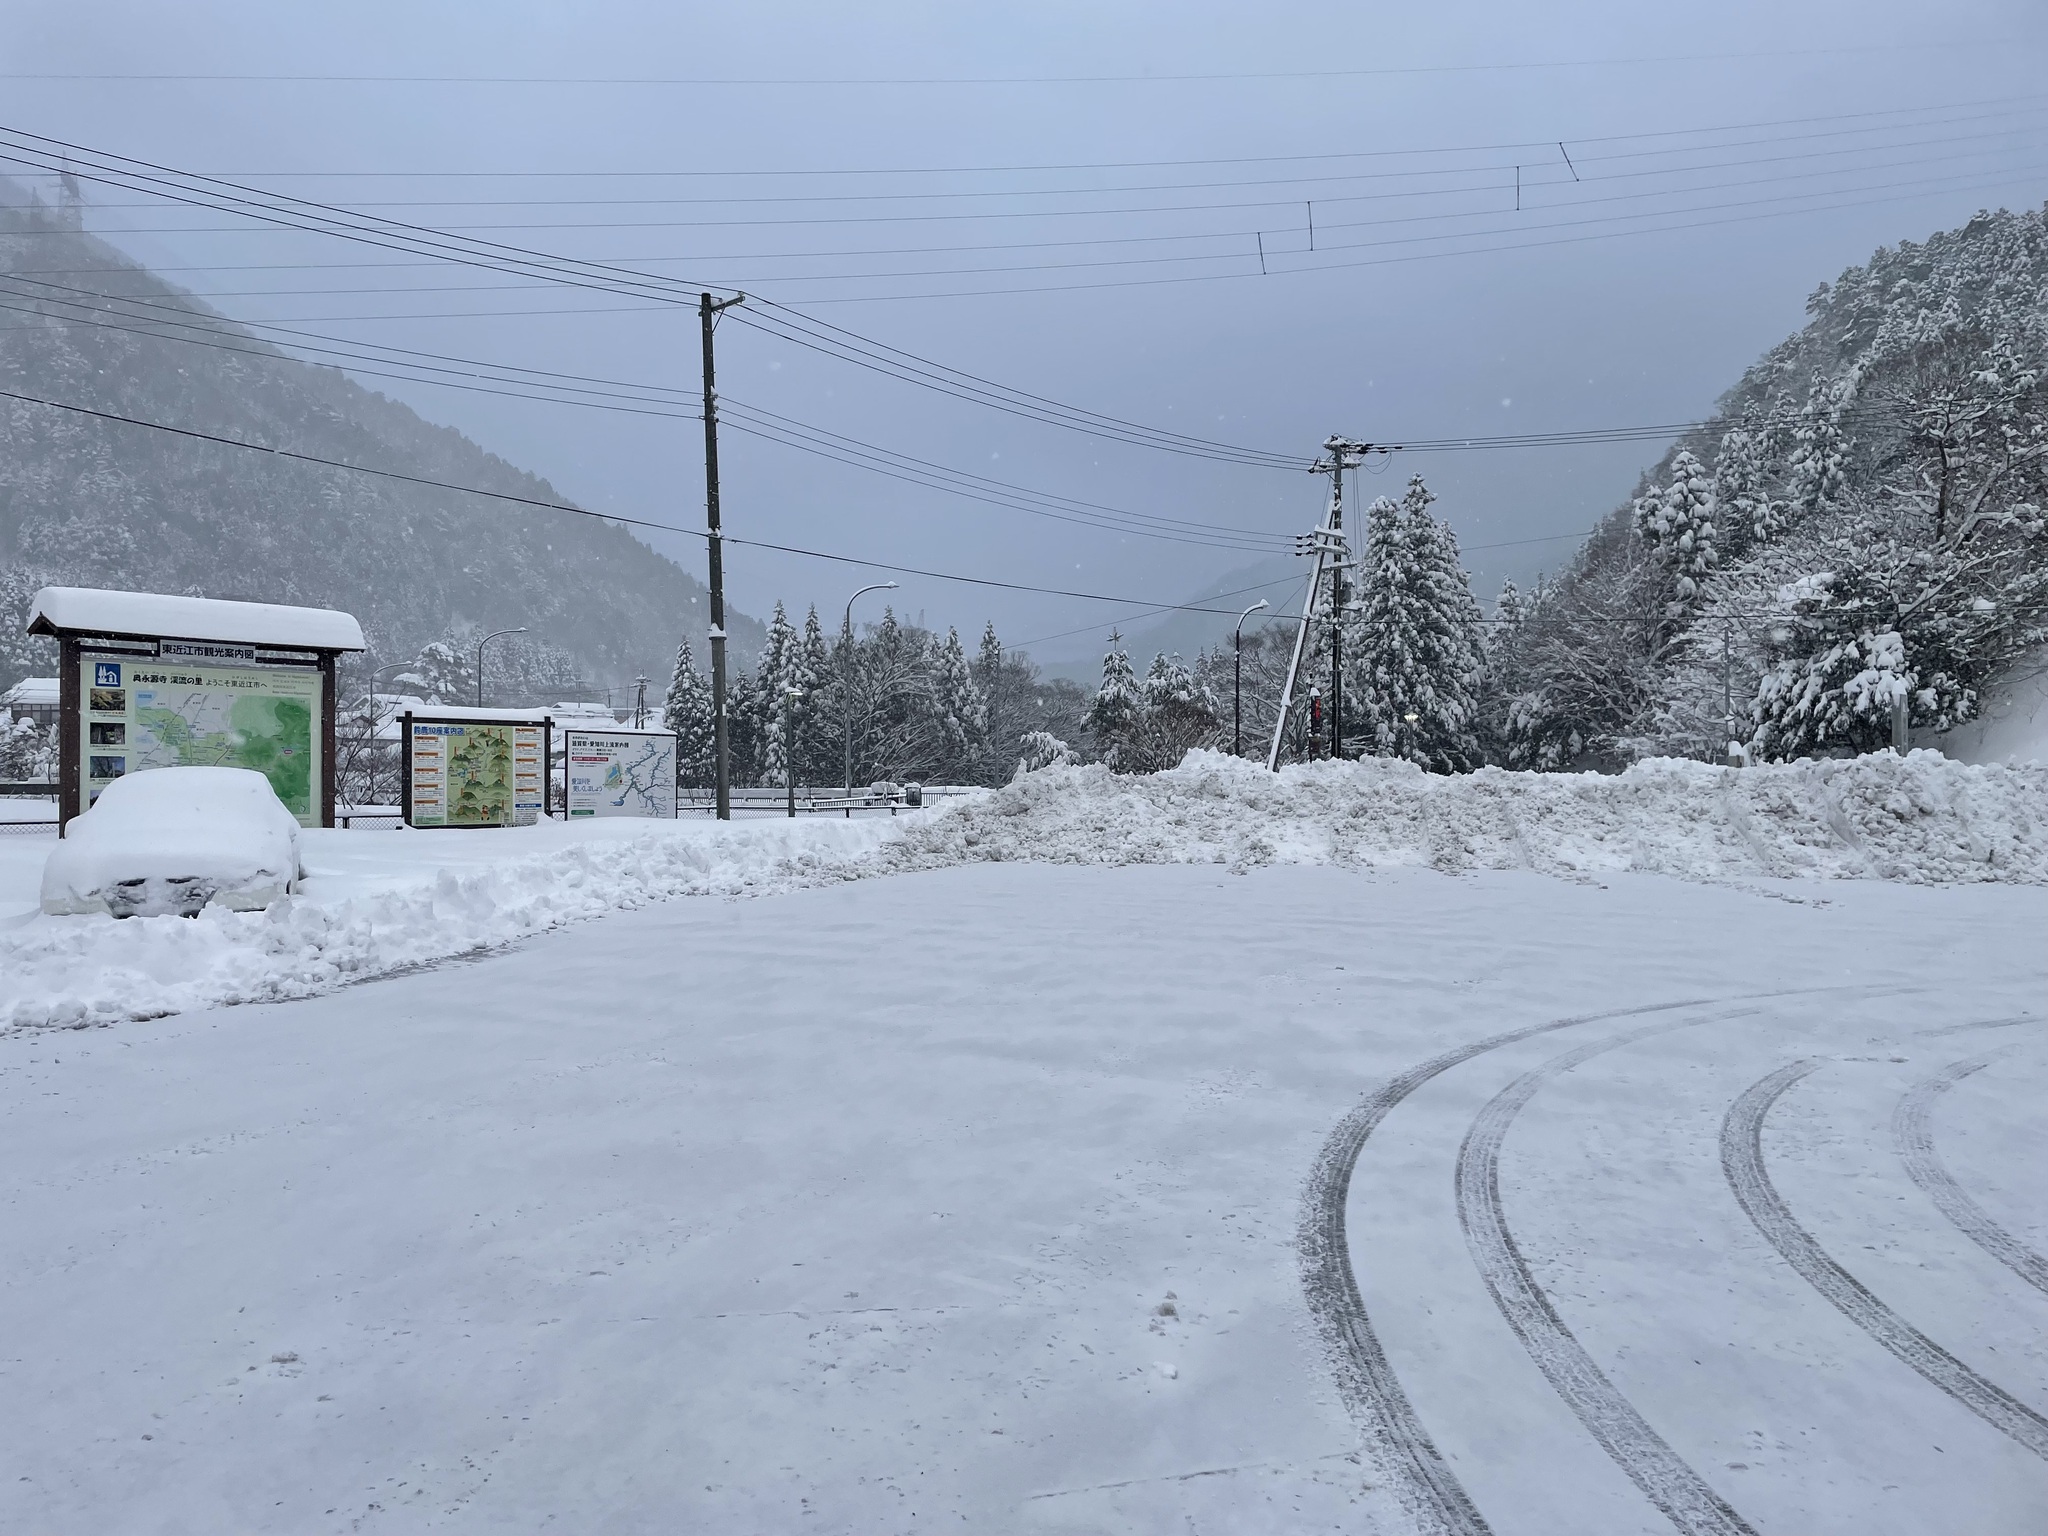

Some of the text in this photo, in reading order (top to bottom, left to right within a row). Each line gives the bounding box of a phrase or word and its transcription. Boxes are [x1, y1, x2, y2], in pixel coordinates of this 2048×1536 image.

[162, 644, 254, 659] 東近江市観光案内図
